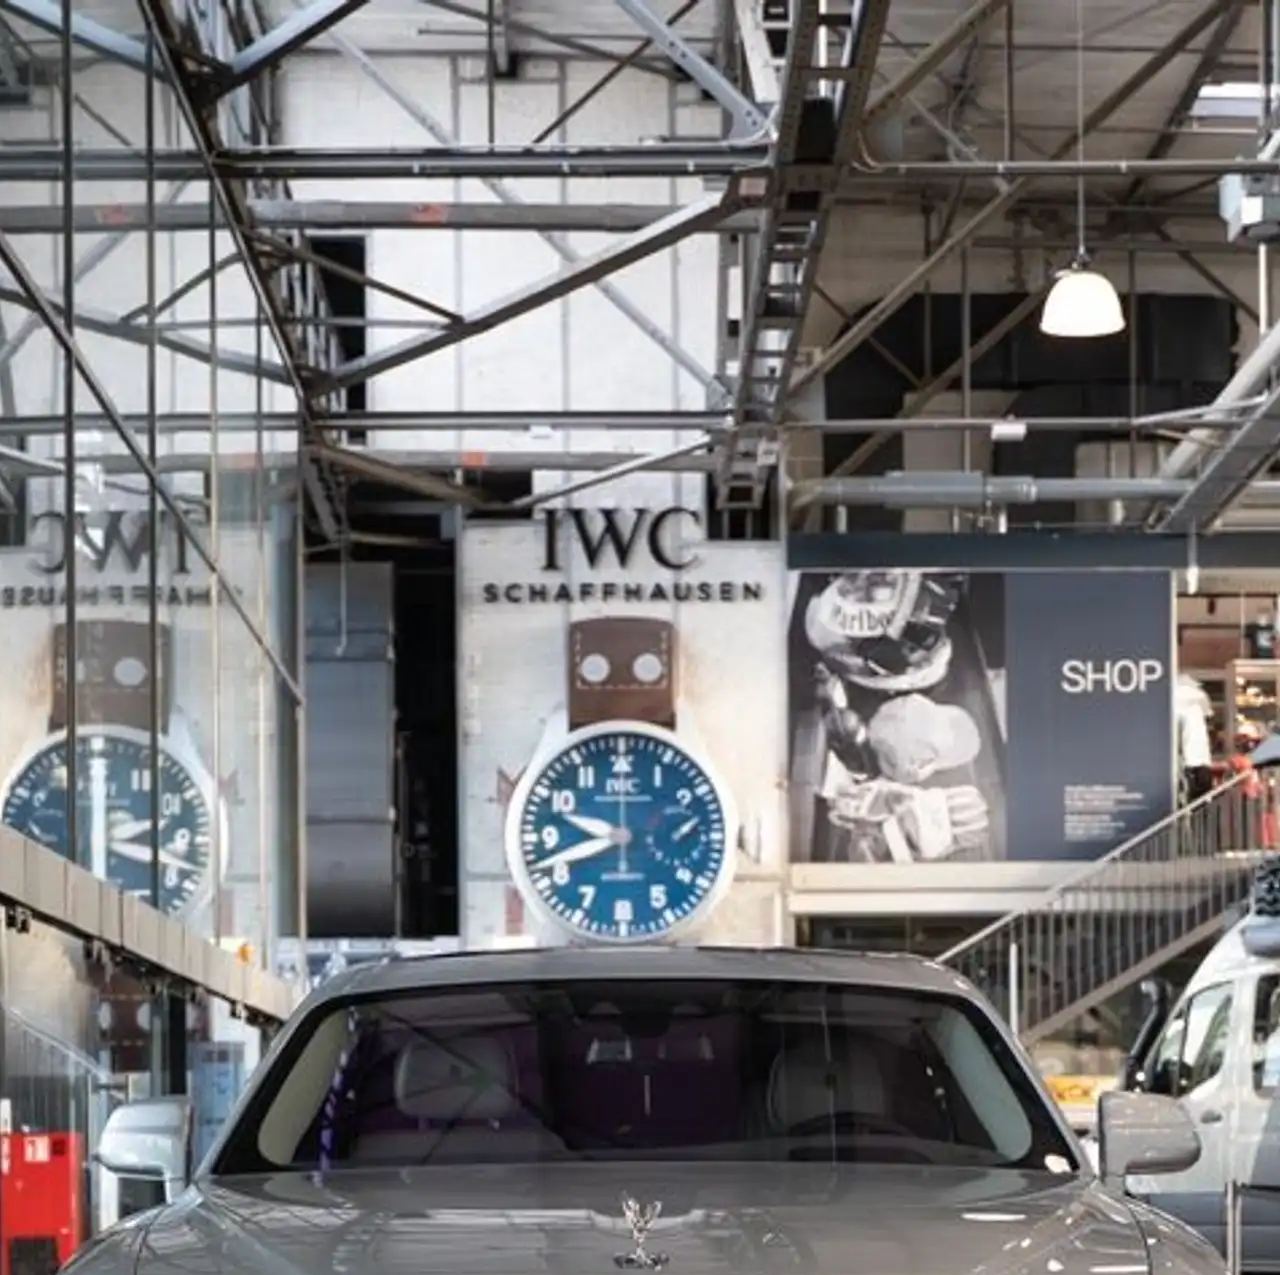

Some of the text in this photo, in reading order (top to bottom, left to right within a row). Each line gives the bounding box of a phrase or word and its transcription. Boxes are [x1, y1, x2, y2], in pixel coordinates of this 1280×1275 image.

[541, 507, 701, 570] IWC
[483, 582, 763, 603] SCHAFFHAUSEN
[1061, 659, 1163, 693] SHOP
[577, 765, 595, 789] 11
[551, 789, 575, 813] 10
